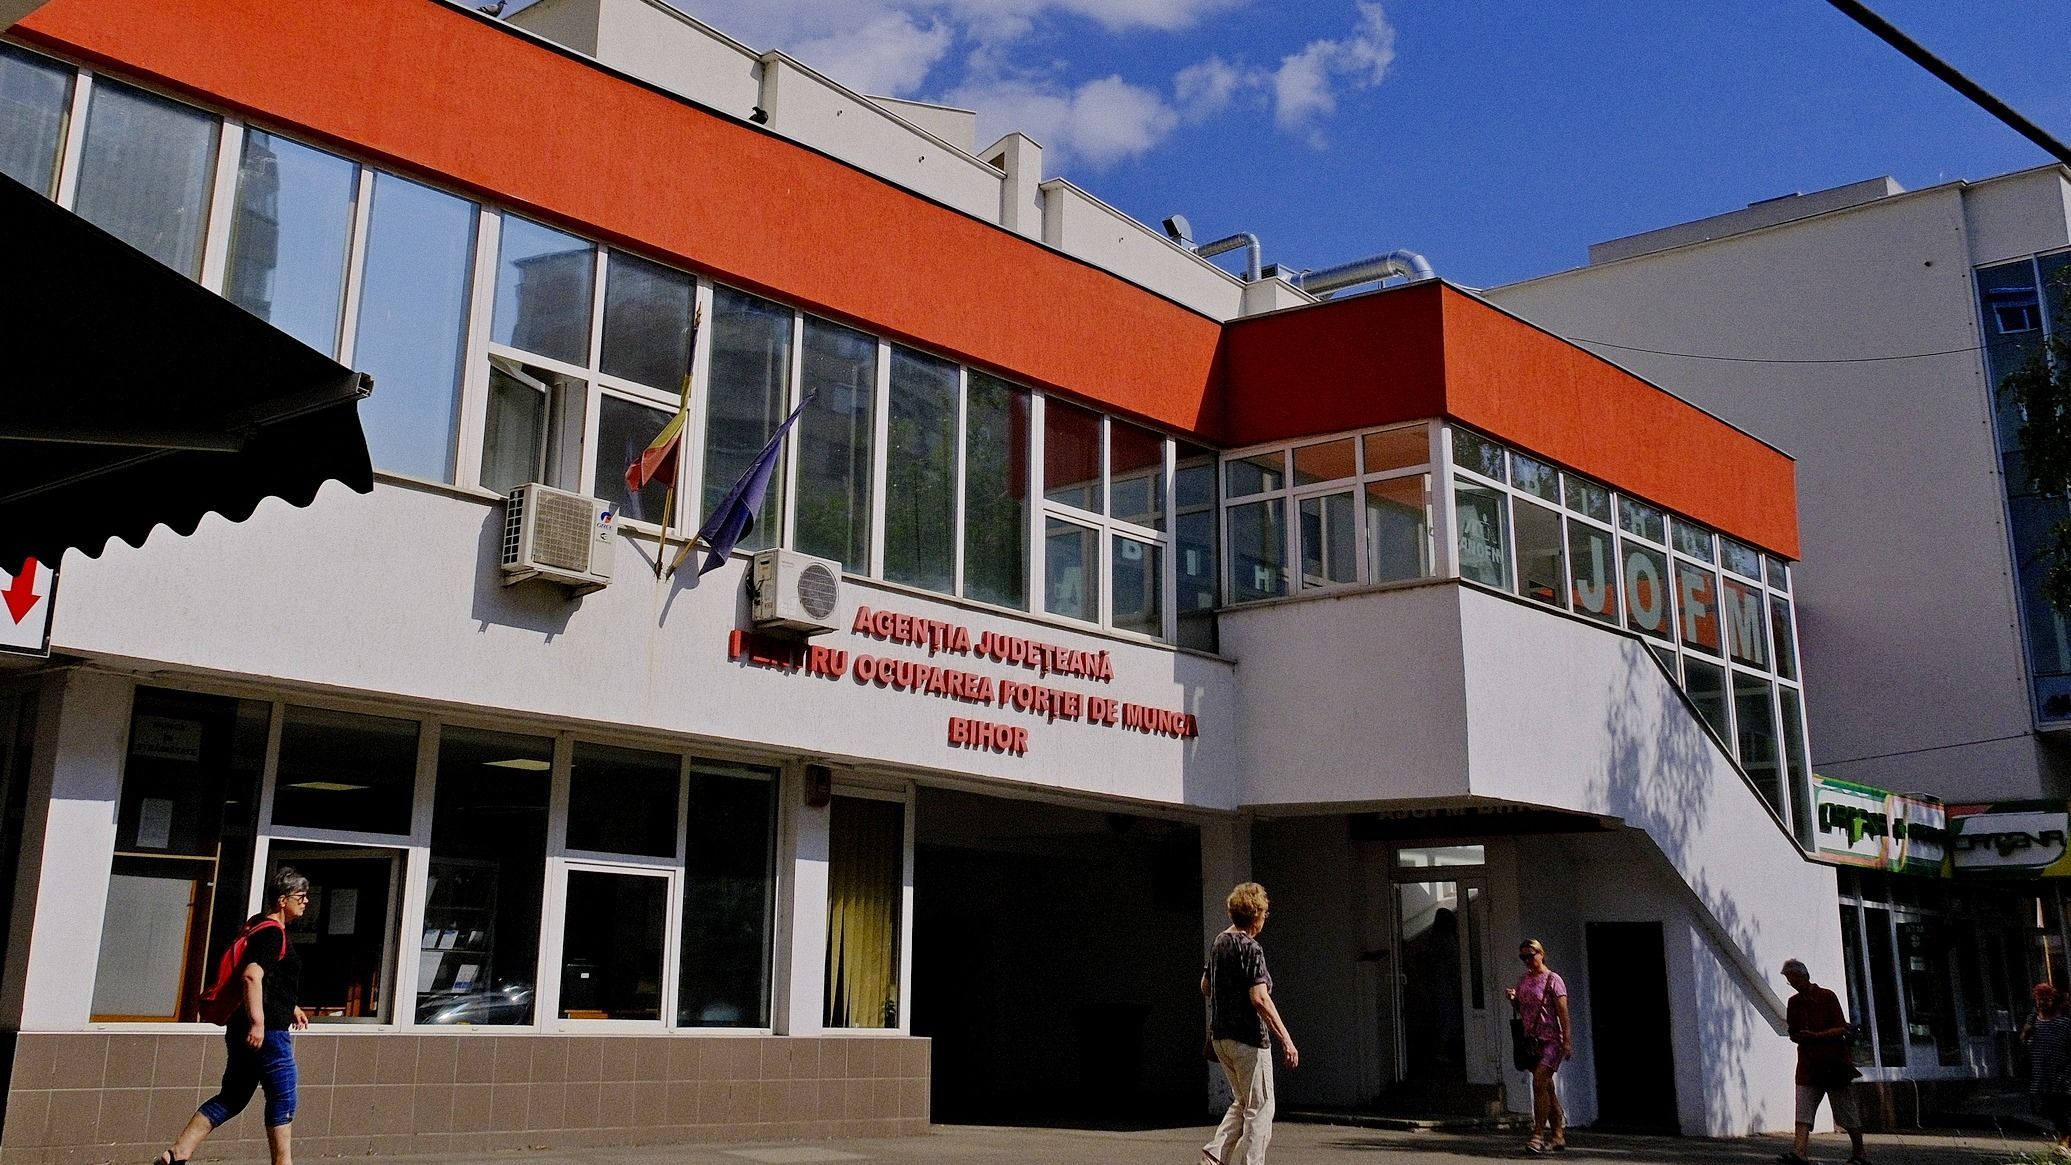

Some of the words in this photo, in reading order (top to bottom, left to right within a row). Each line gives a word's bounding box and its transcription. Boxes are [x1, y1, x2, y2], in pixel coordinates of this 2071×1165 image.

[853, 653, 996, 706] OCUPAREA
[1087, 696, 1119, 728] DE
[948, 716, 1029, 757] BIHOR
